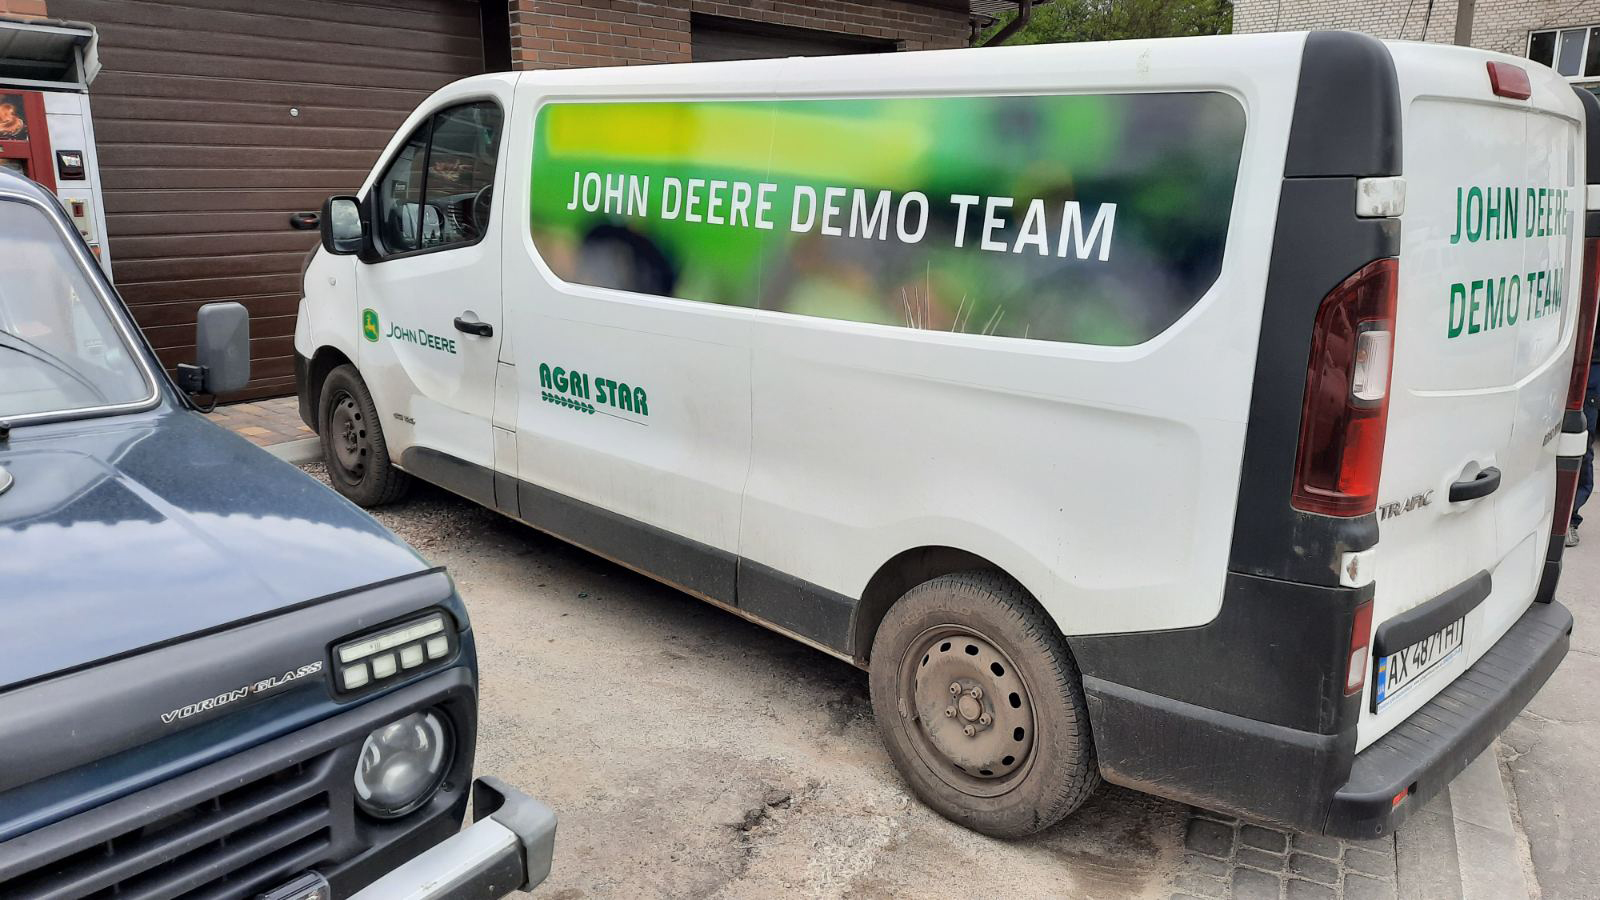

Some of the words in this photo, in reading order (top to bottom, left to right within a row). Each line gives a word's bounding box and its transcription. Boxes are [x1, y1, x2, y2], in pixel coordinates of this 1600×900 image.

[567, 171, 650, 217] JOHN
[661, 177, 777, 230] DEERE
[790, 185, 929, 244] DEMO
[950, 194, 1117, 262] TEAM
[1450, 186, 1519, 244] JOHN
[1525, 187, 1569, 238] DEERE
[1448, 274, 1521, 339] DEMO
[1526, 266, 1564, 321] TEAM
[386, 321, 418, 344] JOHN
[418, 329, 457, 355] DEERE
[539, 362, 590, 400] AGRI
[594, 377, 649, 417] STAR
[1379, 488, 1434, 521] TRAFIC
[161, 686, 249, 724] VORON
